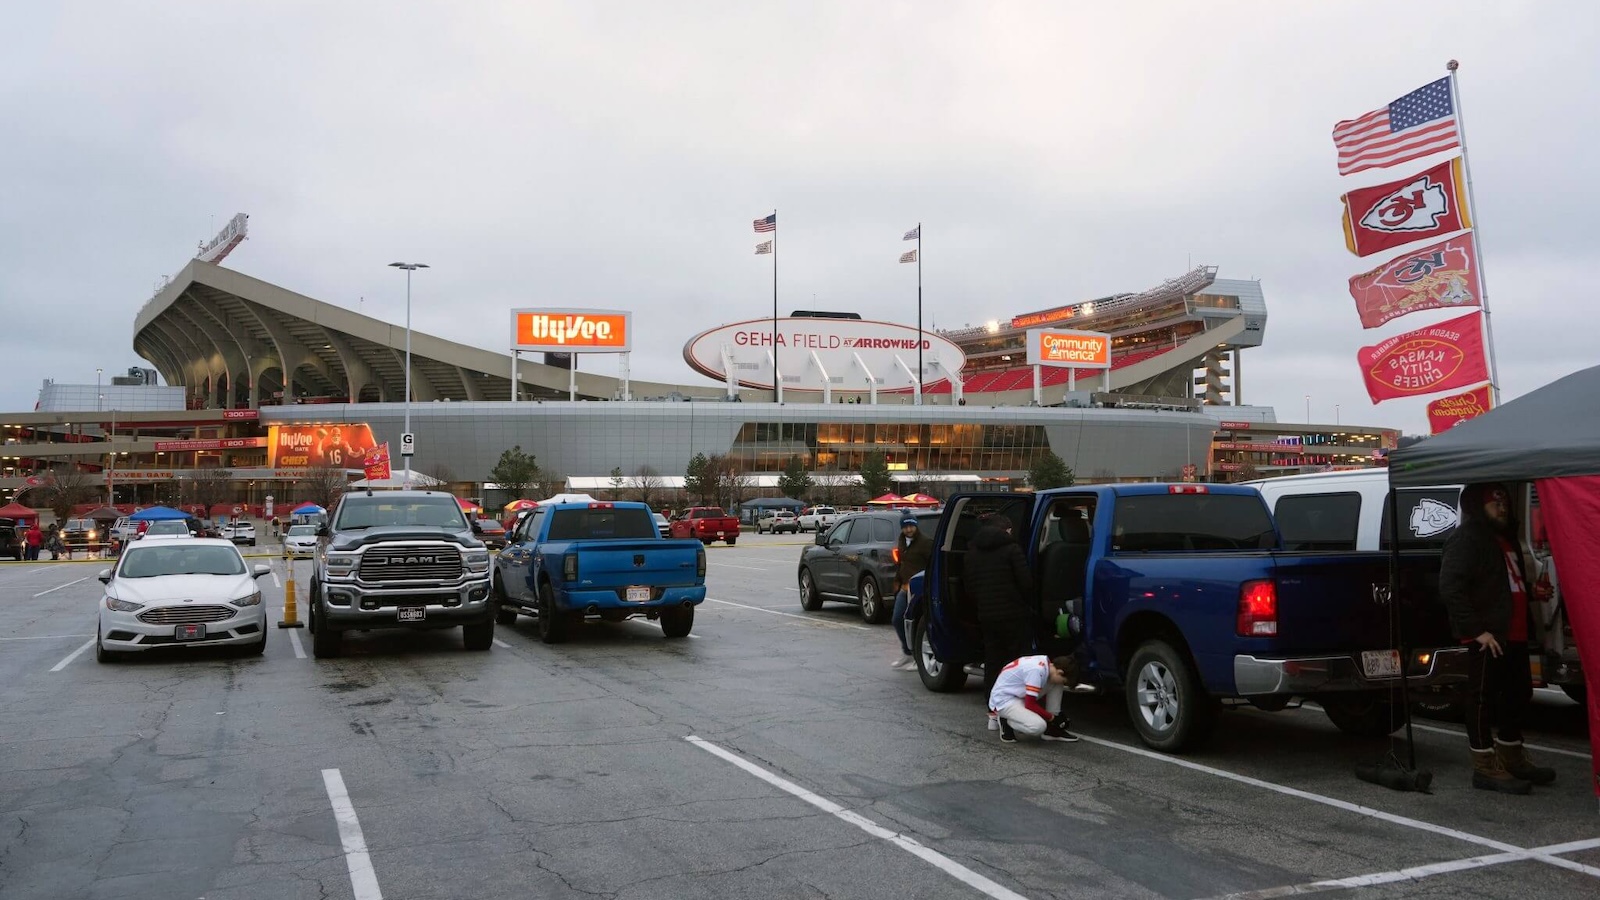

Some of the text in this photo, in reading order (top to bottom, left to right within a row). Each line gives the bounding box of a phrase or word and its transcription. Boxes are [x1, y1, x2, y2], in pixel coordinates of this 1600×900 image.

[532, 315, 611, 344] HyVee
[735, 331, 931, 350] GEHA FIELD AT ARROWHEAD
[1043, 335, 1103, 353] Community
[403, 435, 412, 444] G
[280, 455, 309, 465] CHIEFS
[329, 449, 342, 465] 16
[390, 556, 433, 564] RAM
